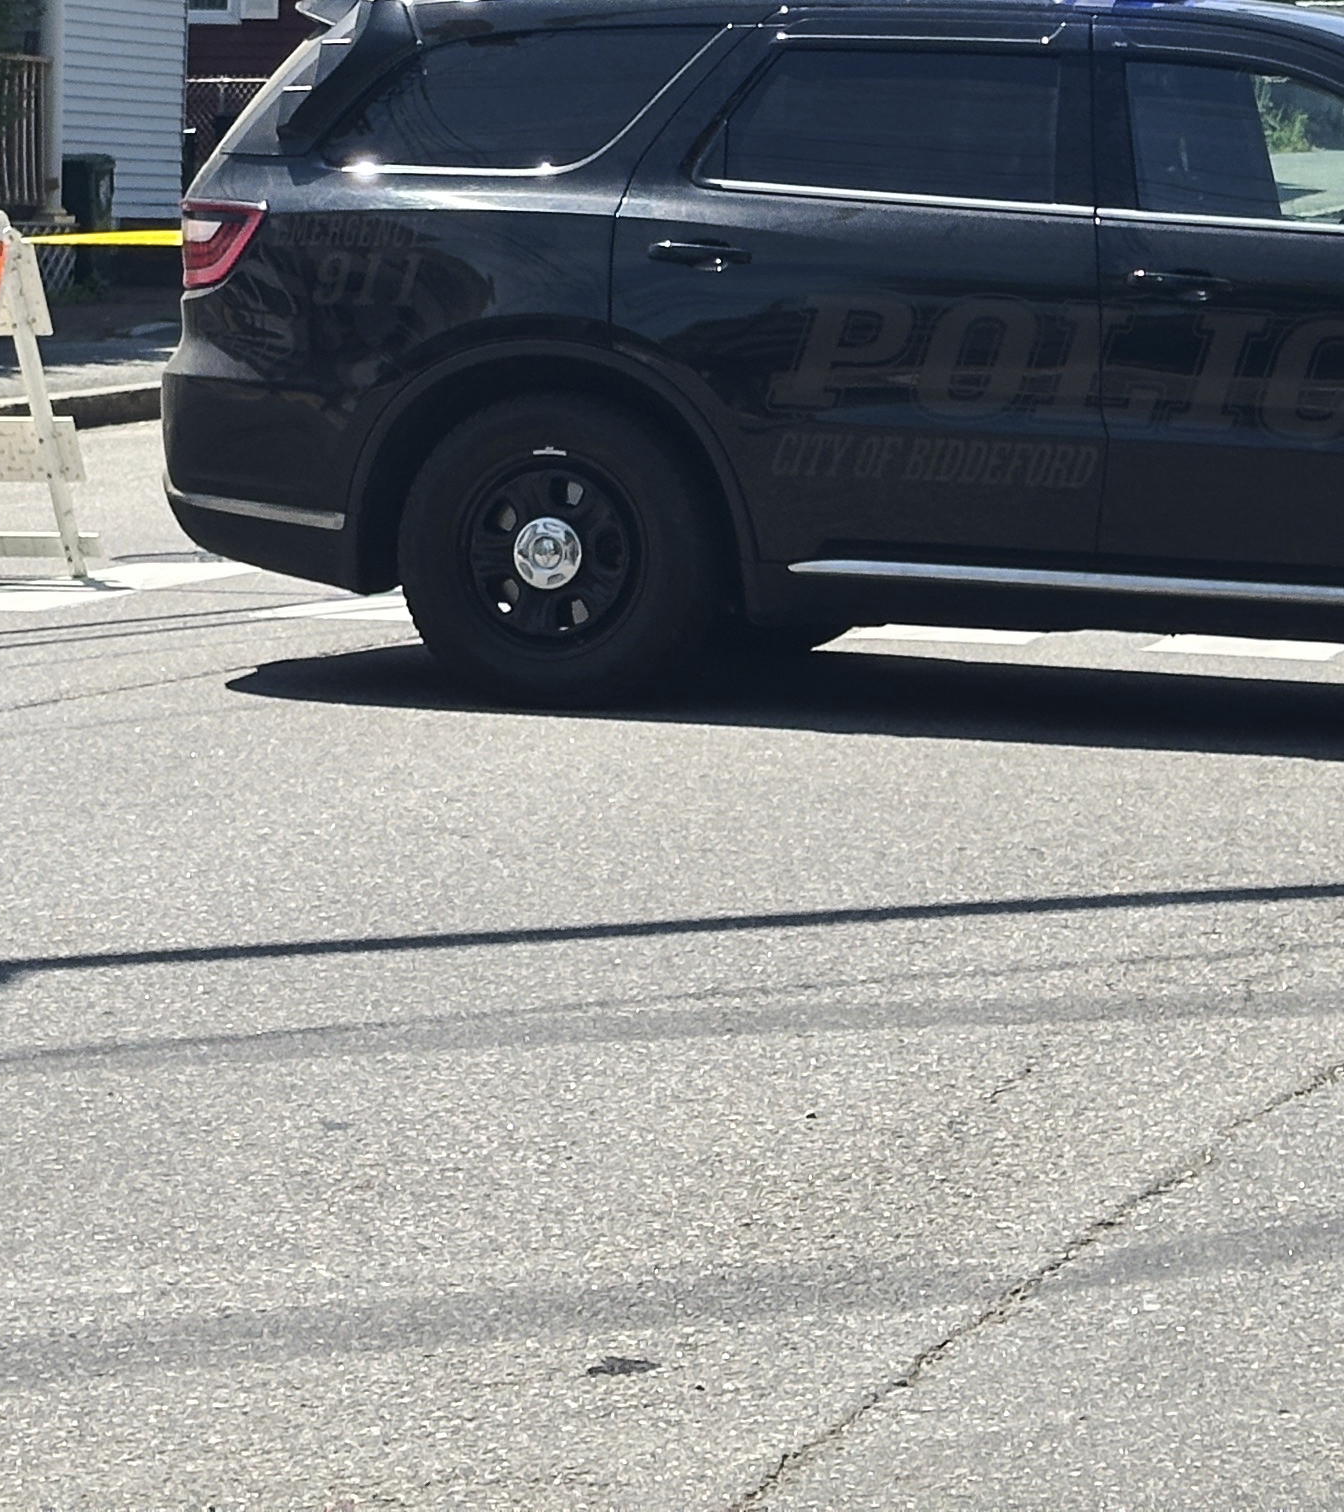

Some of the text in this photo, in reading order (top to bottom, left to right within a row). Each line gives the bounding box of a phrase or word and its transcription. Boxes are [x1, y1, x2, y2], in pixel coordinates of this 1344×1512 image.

[312, 250, 422, 306] 911
[770, 431, 1099, 490] CITY OF BIDDEFORD
